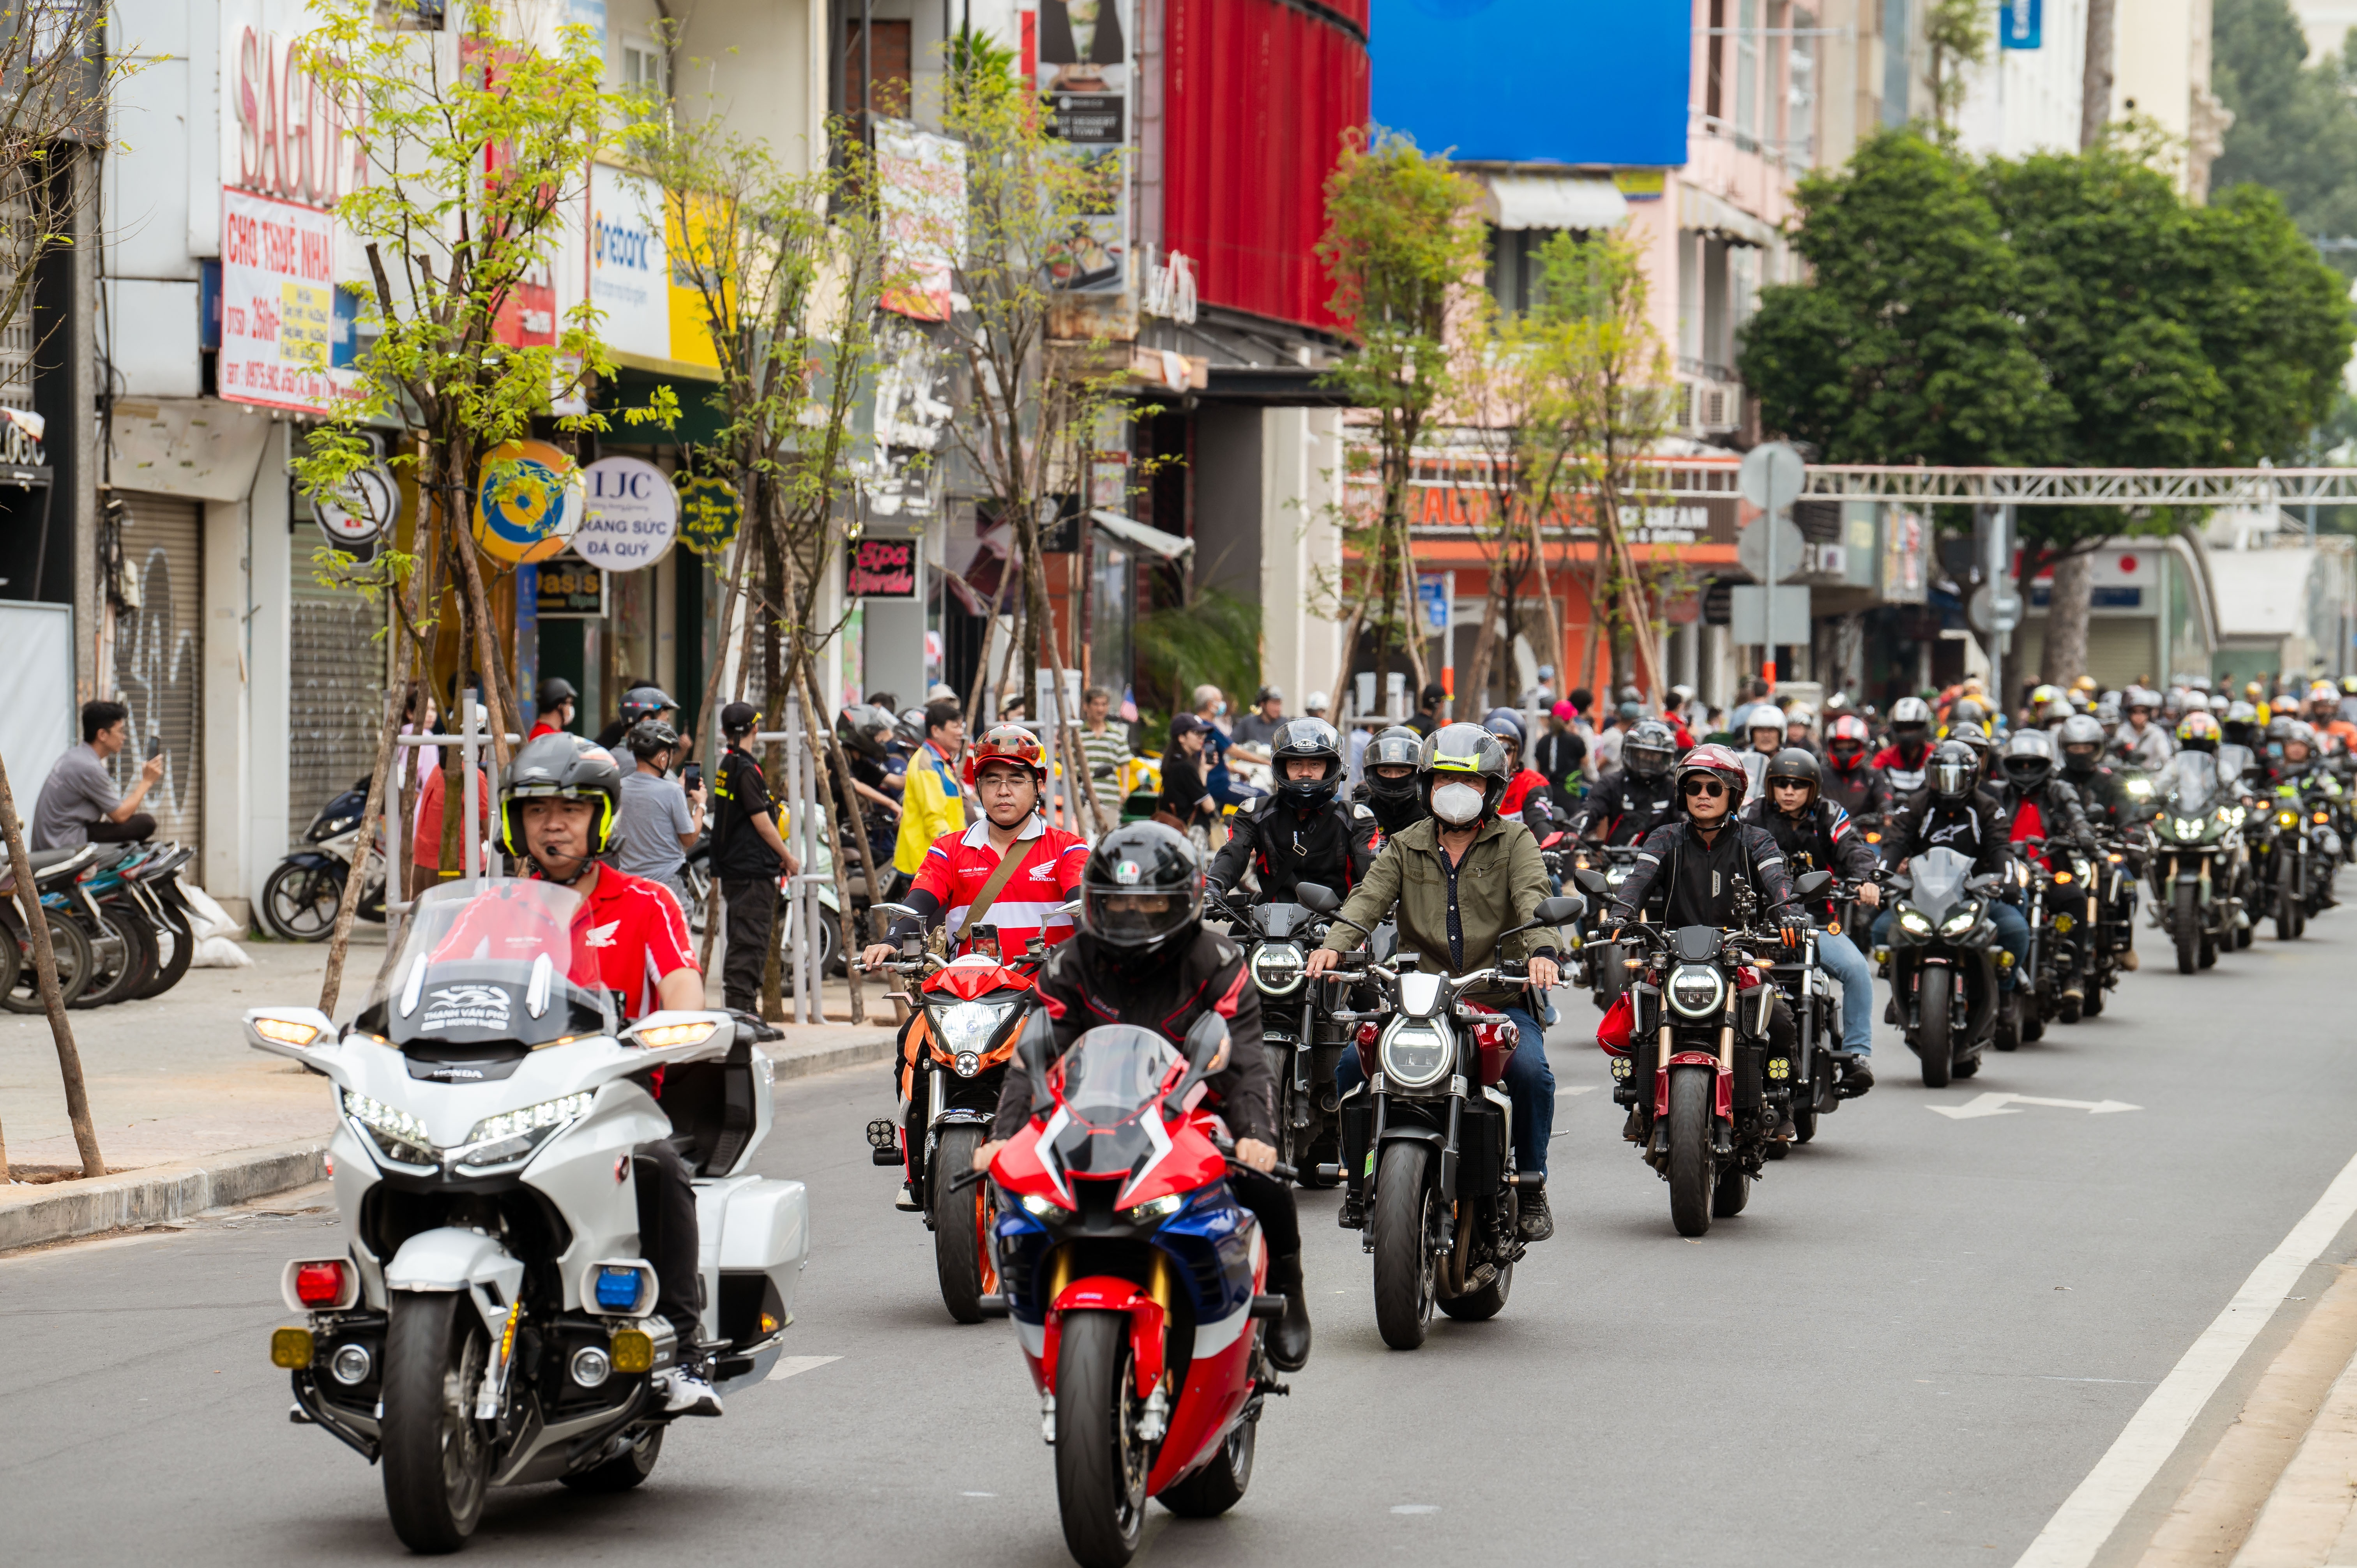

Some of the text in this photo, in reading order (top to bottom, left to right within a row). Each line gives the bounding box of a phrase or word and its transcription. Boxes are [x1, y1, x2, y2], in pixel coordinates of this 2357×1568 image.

[228, 213, 330, 282] CHO THUÊ NHÀ
[590, 470, 652, 501] IJC
[632, 517, 667, 535] SỨC
[614, 540, 649, 557] QUÝ
[858, 541, 909, 571] Spa
[423, 1008, 460, 1021] THANH
[432, 1069, 484, 1079] HONDA
